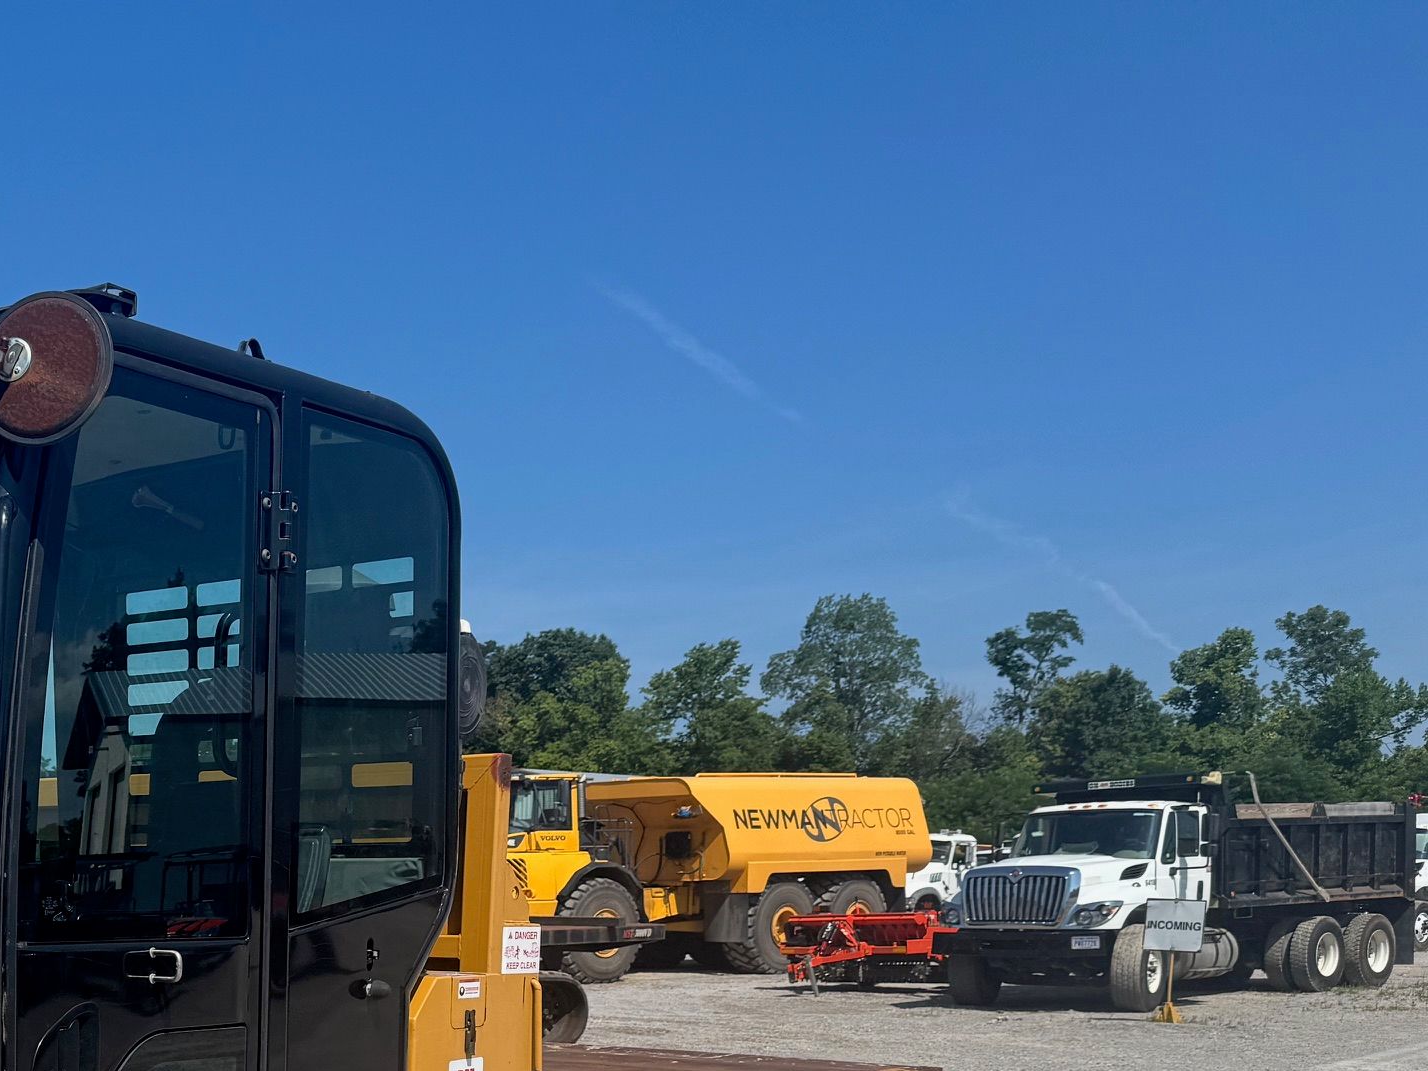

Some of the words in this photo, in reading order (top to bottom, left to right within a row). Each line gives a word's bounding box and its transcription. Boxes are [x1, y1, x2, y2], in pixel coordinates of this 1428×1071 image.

[733, 809, 829, 830] NEWMAN
[1147, 920, 1202, 931] INCOMING
[514, 931, 538, 940] DANGER
[506, 962, 519, 970] KEEP
[520, 961, 537, 969] CLEAR
